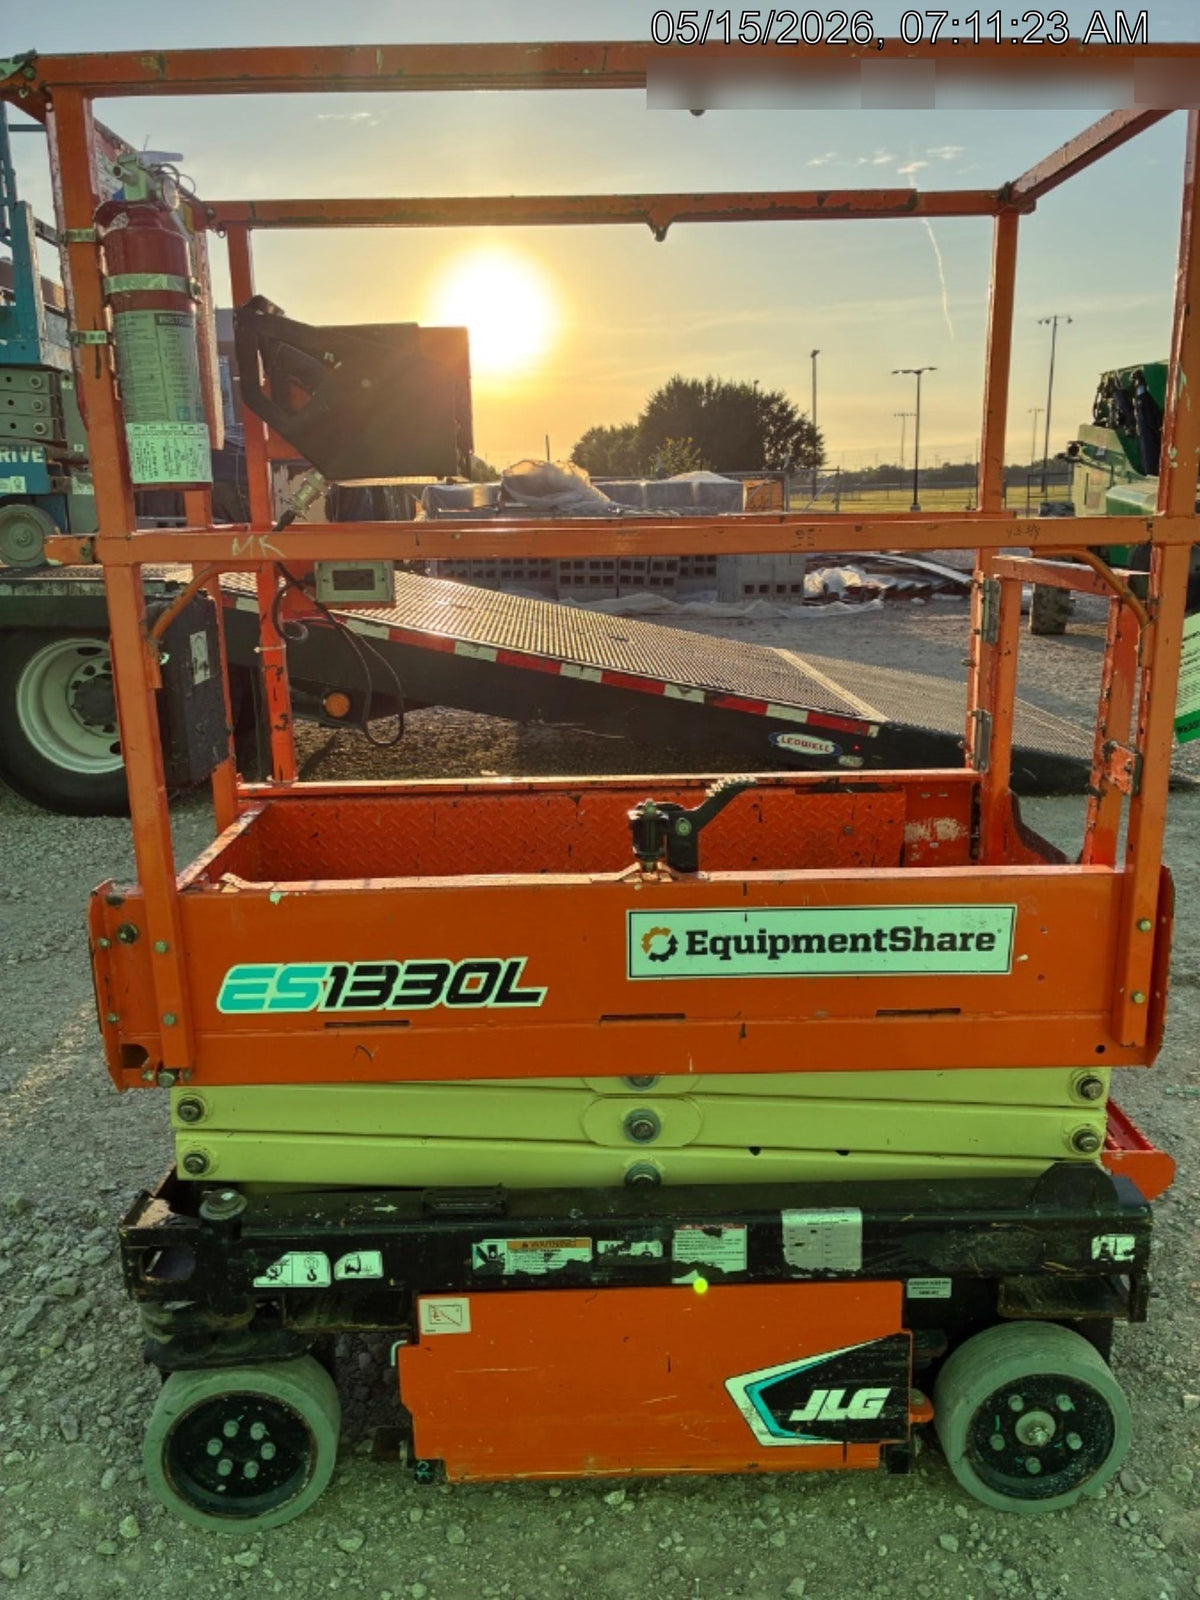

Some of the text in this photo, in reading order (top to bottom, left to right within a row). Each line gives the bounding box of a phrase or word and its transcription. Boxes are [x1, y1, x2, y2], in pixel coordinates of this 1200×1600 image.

[781, 735, 832, 753] LEDWELL
[685, 926, 996, 961] EquipmentShare
[217, 958, 547, 1012] ES1330L
[789, 1388, 891, 1421] JLG
